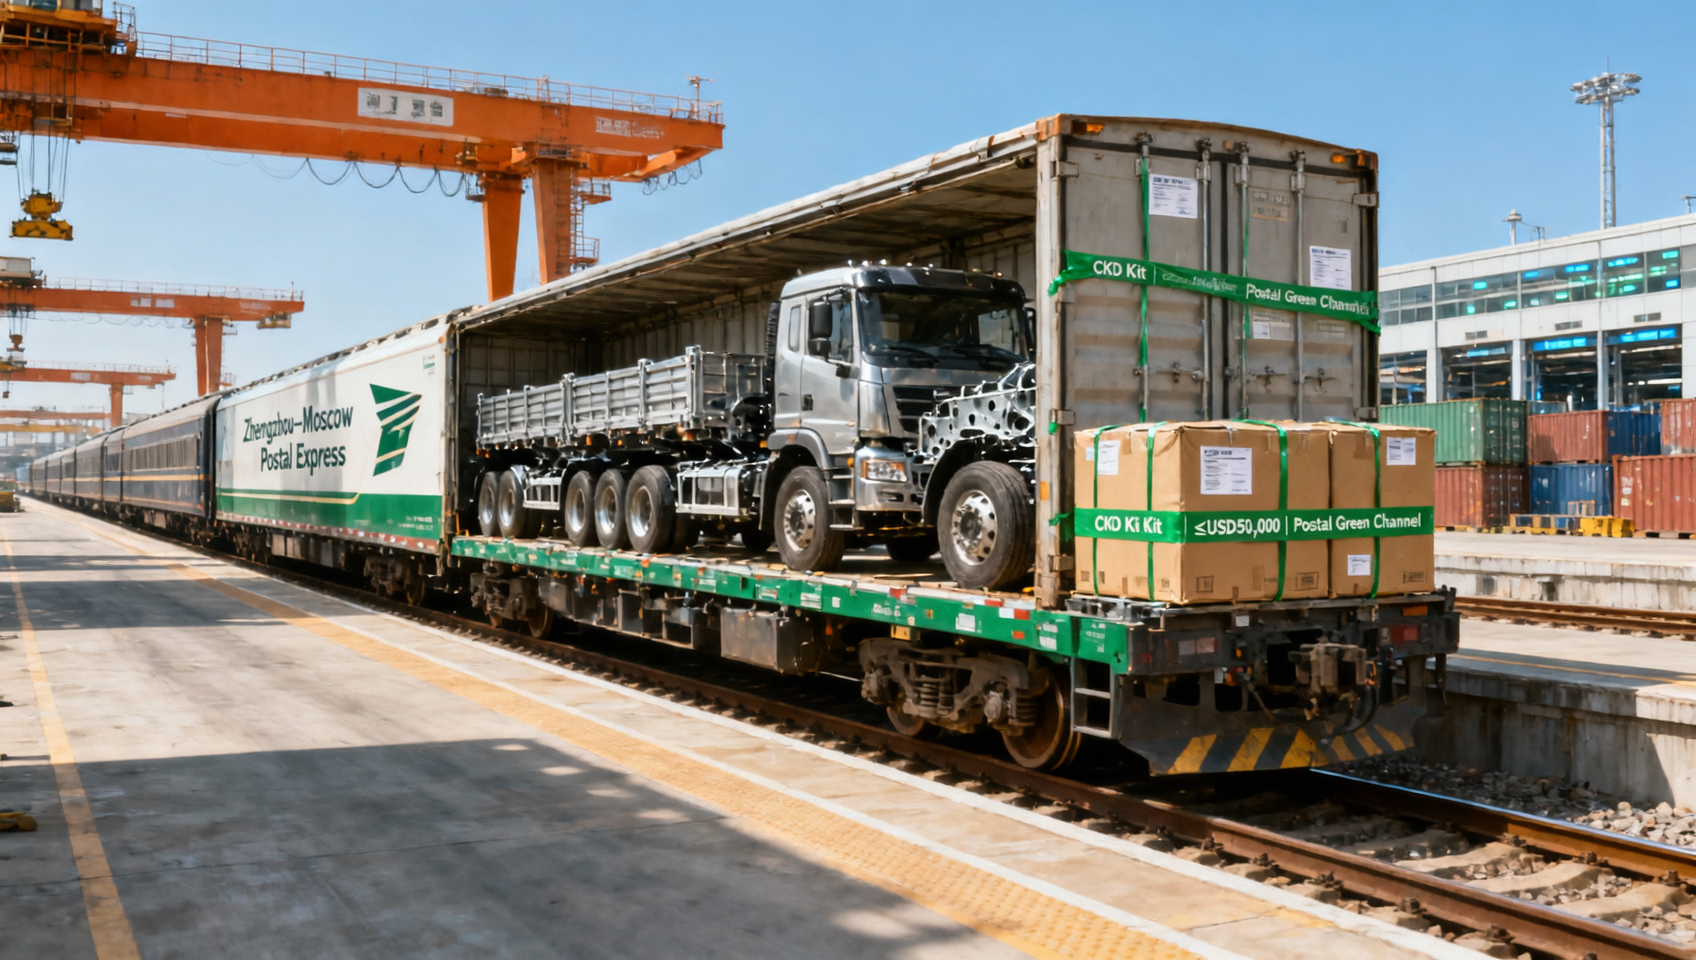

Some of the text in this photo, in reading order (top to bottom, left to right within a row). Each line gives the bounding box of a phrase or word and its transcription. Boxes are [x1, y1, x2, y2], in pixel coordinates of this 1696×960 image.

[1093, 260, 1123, 277] CKD
[1126, 263, 1147, 280] Kit
[261, 442, 347, 476] Postal Express
[1142, 516, 1163, 535] Kit
[1293, 515, 1333, 533] Postal
[1335, 515, 1370, 531] Green
[1373, 512, 1422, 529] Channel
